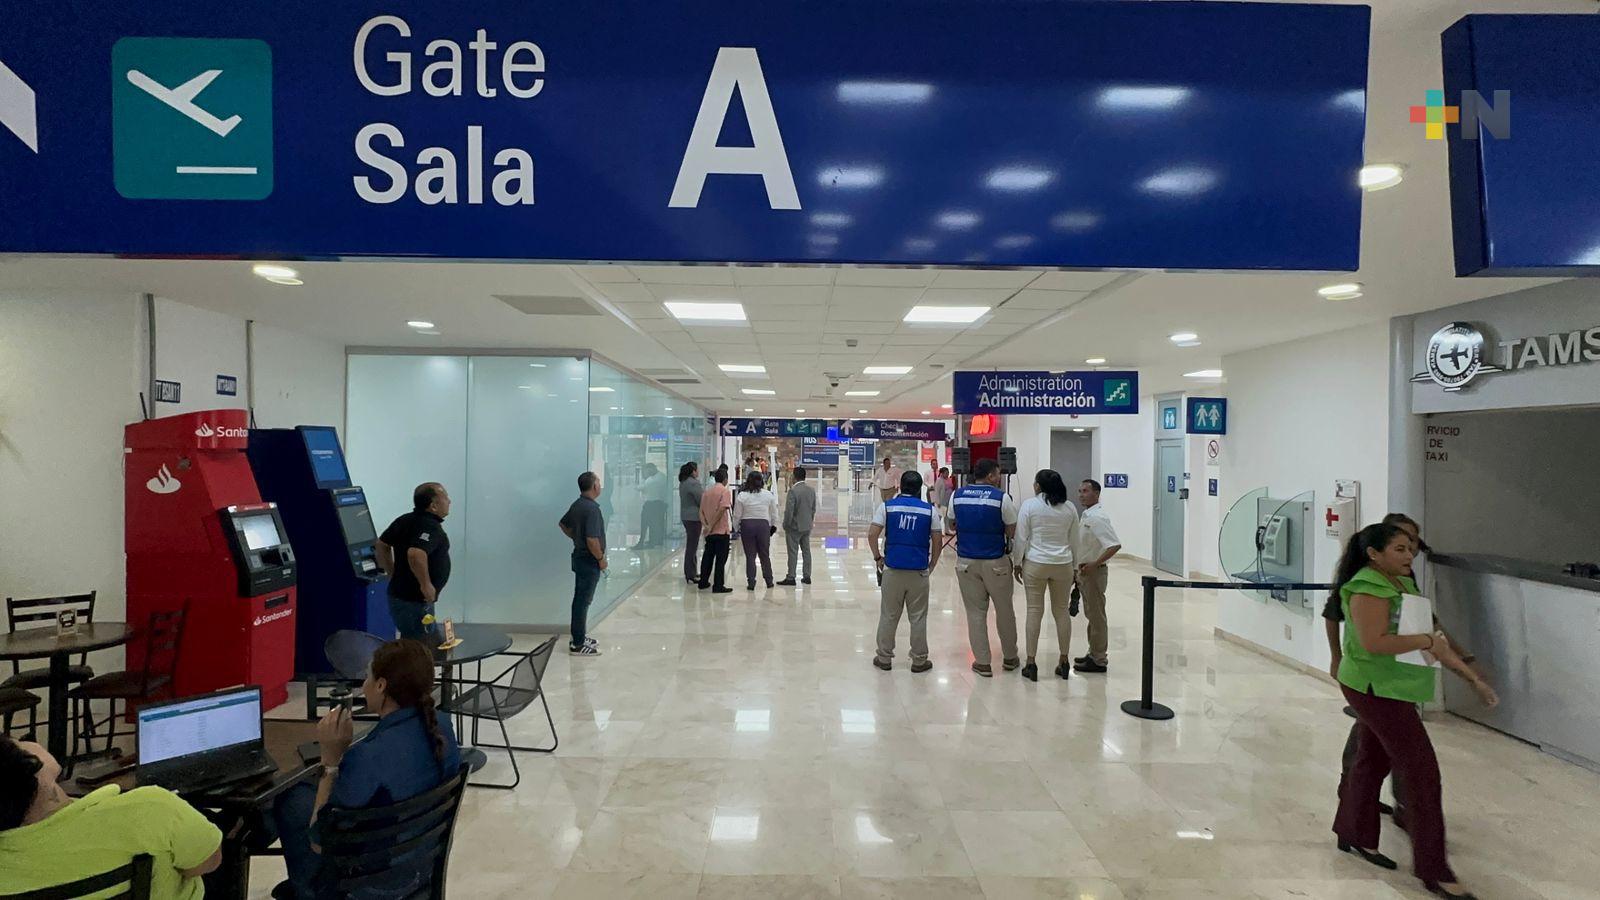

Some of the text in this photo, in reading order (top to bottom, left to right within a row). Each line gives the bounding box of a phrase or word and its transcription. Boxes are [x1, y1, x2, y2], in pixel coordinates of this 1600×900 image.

[352, 15, 547, 99] Gate
[668, 47, 802, 210] A
[352, 123, 535, 206] Sala
[978, 375, 1083, 391] Administration
[978, 392, 1096, 408] Administración
[745, 421, 757, 434] A
[1429, 438, 1444, 448] DE
[1425, 451, 1449, 462] TAXI
[898, 514, 917, 530] MTT
[262, 609, 292, 624] Santander
